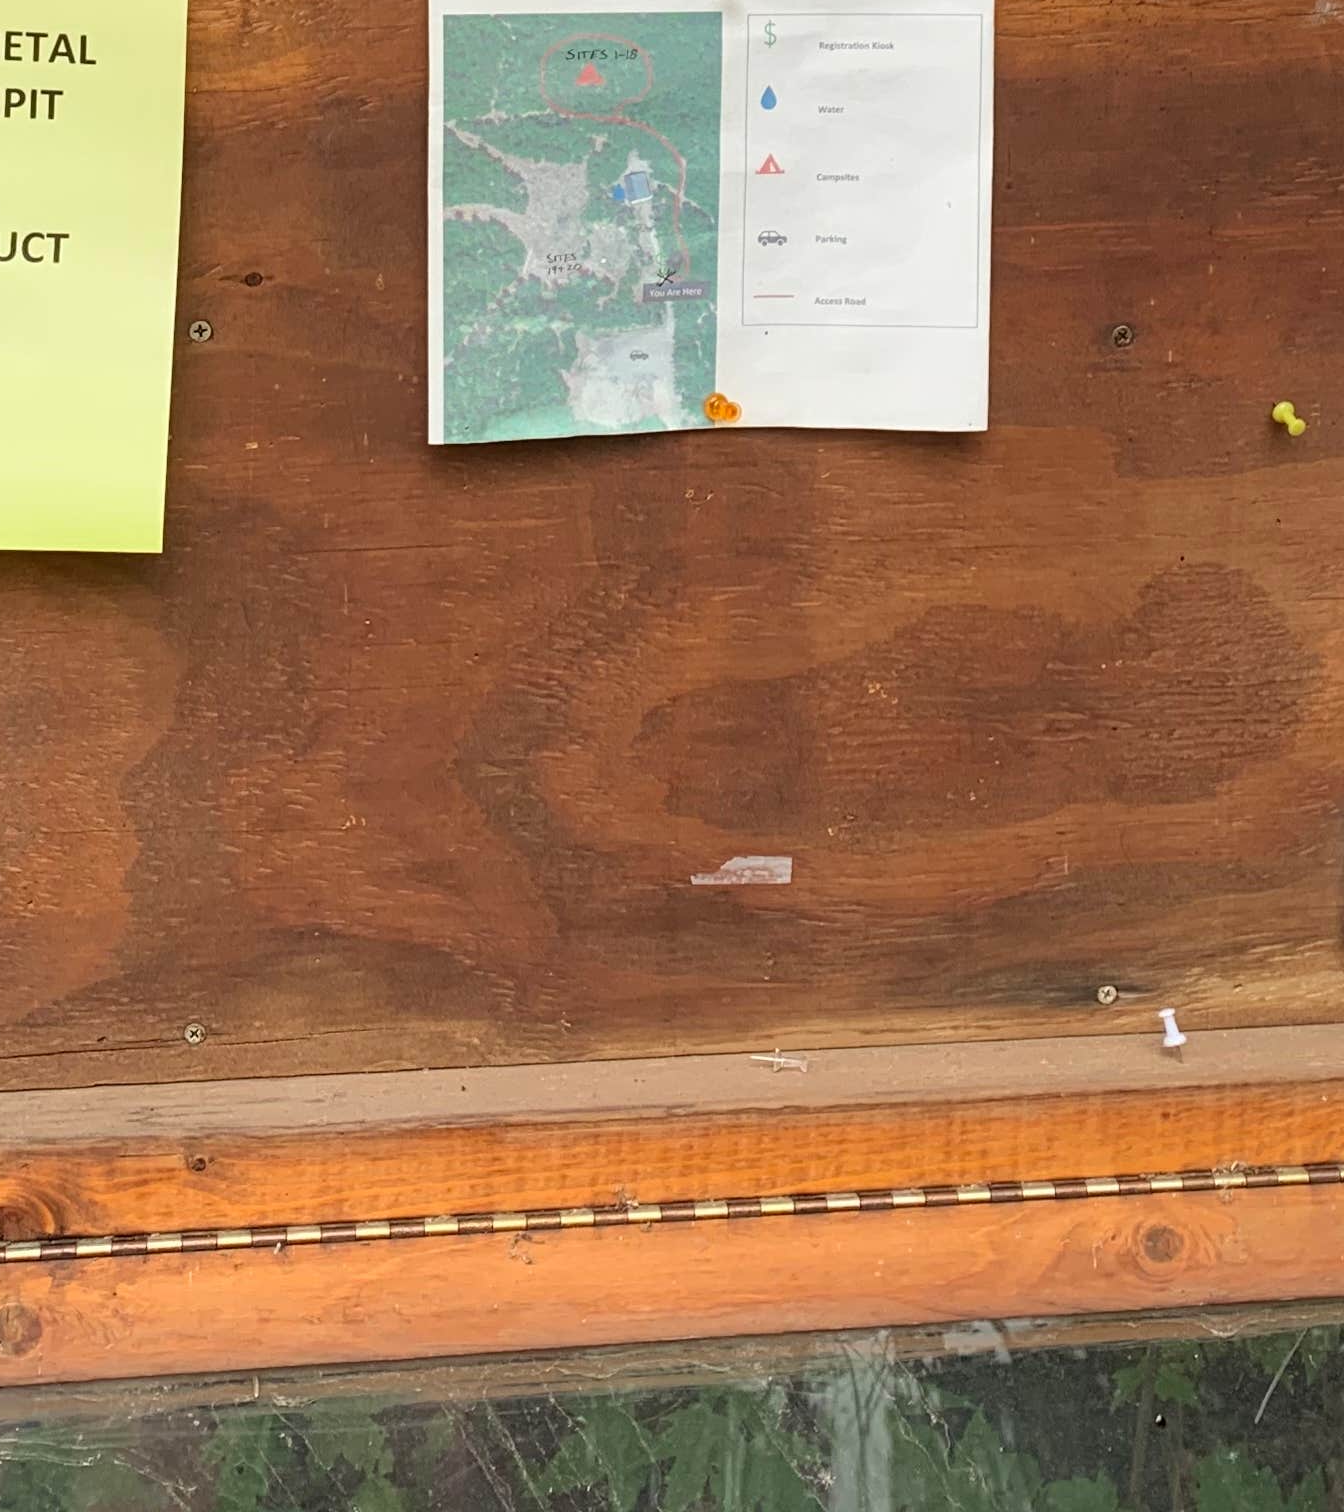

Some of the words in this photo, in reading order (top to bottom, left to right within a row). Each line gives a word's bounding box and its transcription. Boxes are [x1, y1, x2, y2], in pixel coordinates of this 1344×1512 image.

[818, 40, 871, 53] Registration
[871, 40, 895, 51] Kiosk
[817, 104, 845, 115] Water
[815, 172, 860, 184] Campsites
[815, 234, 848, 246] Parking
[649, 288, 666, 297] You
[667, 288, 680, 297] Are
[681, 287, 703, 296] Here
[813, 296, 843, 307] Access
[844, 296, 867, 307] Road
